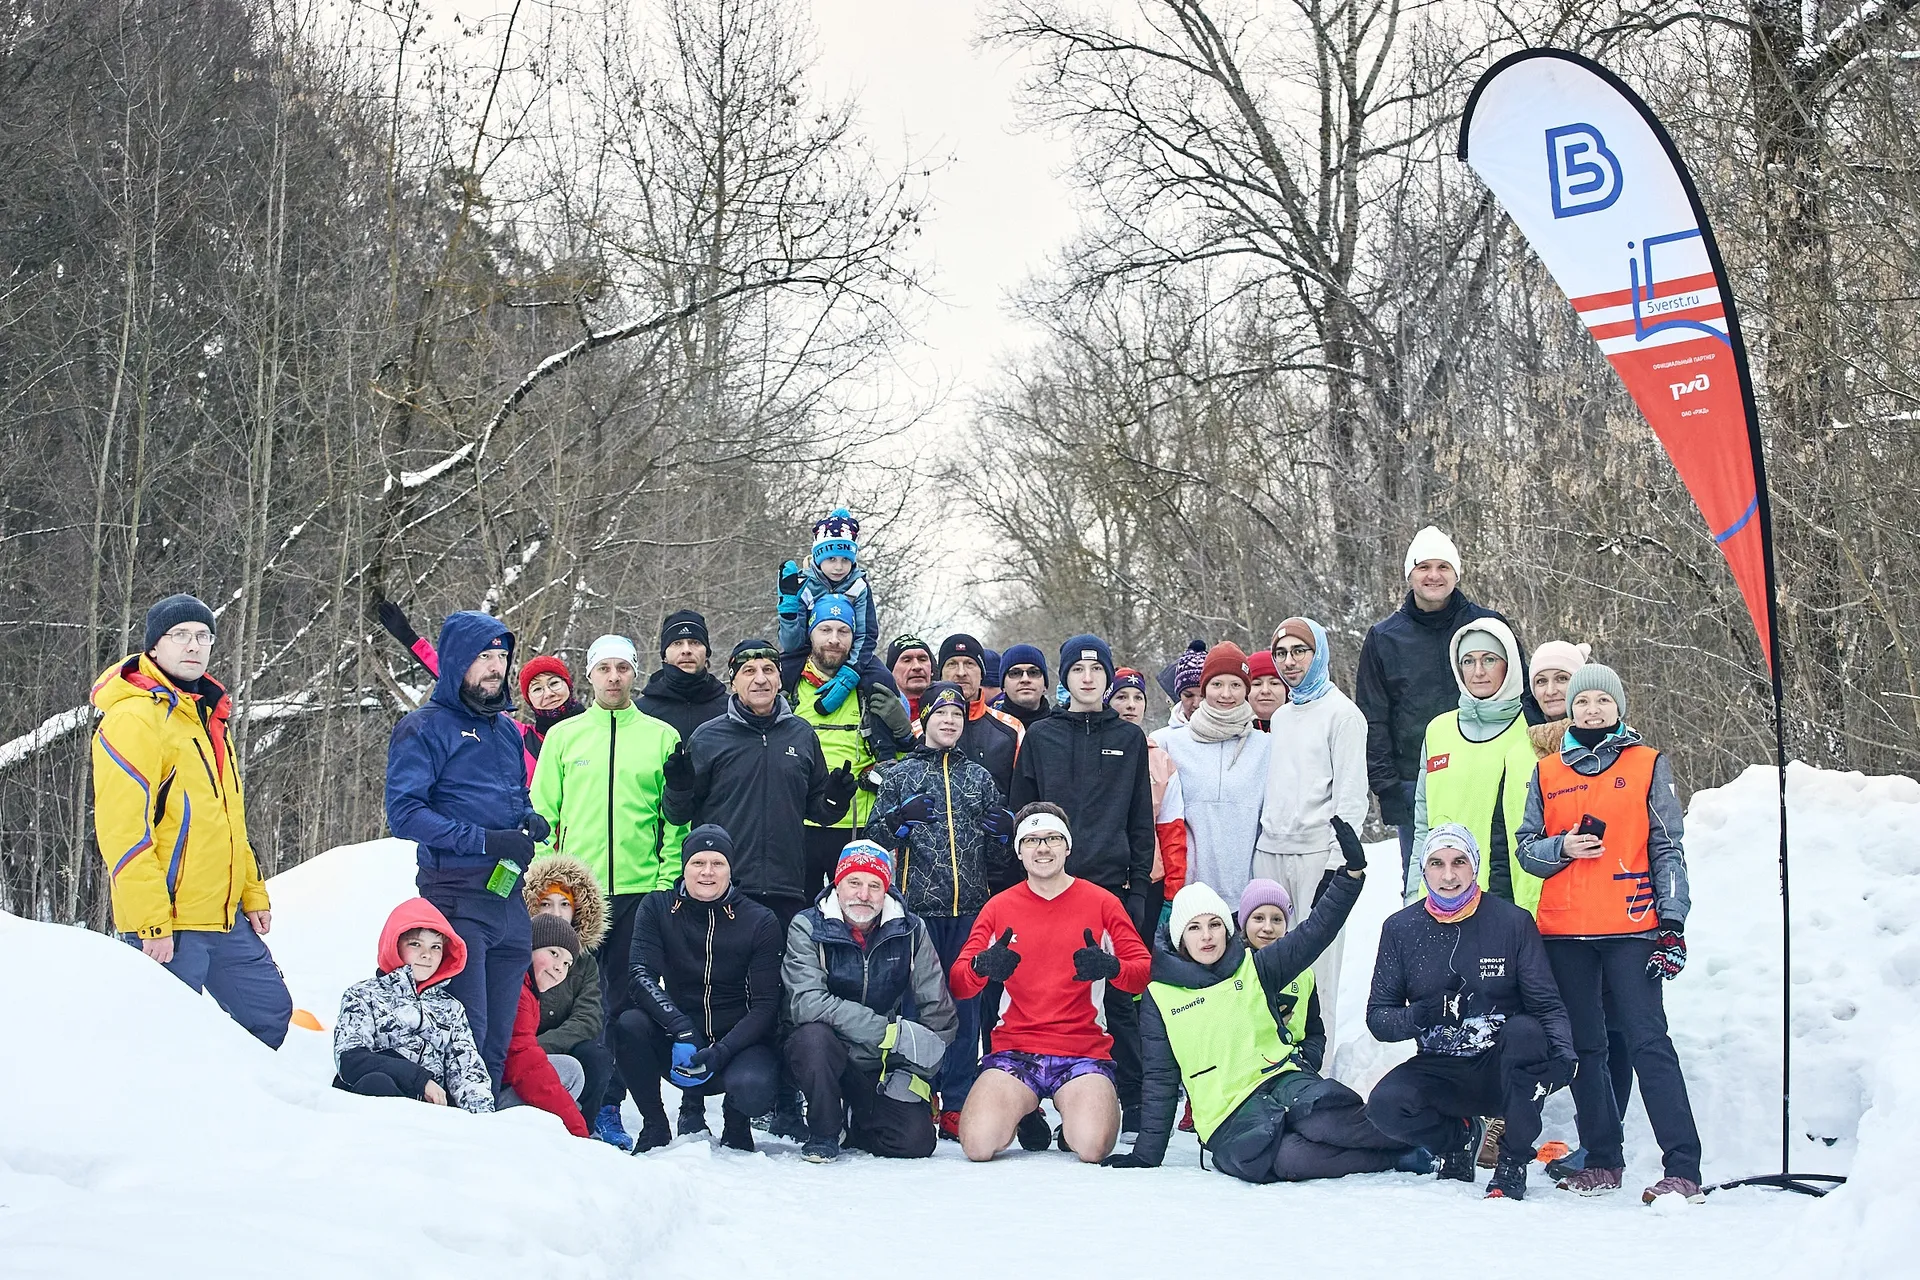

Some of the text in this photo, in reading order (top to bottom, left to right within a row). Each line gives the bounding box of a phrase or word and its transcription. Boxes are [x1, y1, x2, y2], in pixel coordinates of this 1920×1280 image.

[1647, 295, 1700, 314] 5verst.ru
[1653, 357, 1693, 370] ОФИЦИАЛЬНЫЙ
[825, 544, 834, 552] IT
[1547, 784, 1588, 800] Организатор
[1171, 996, 1205, 1015] Волонтёр
